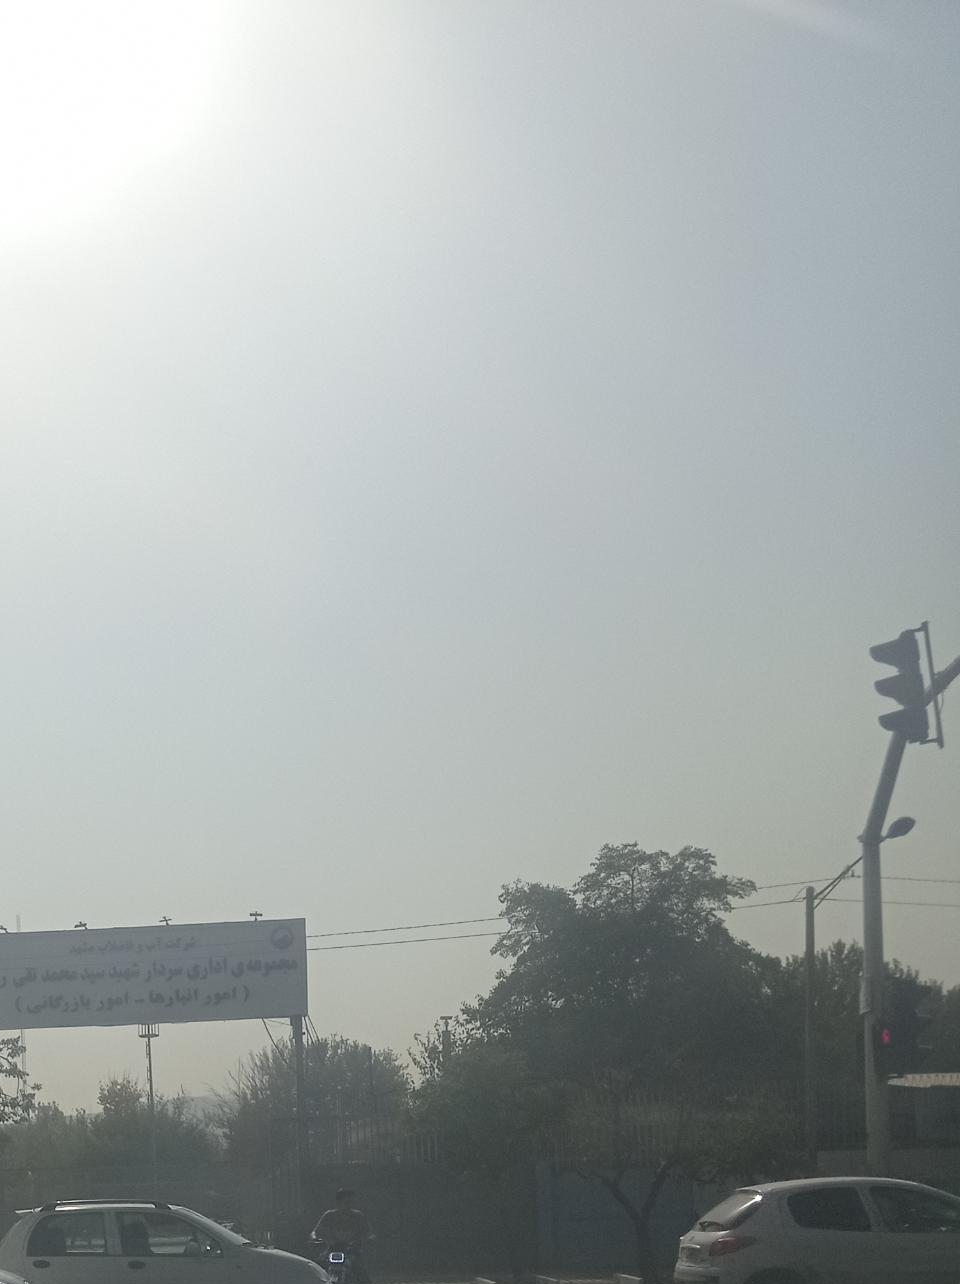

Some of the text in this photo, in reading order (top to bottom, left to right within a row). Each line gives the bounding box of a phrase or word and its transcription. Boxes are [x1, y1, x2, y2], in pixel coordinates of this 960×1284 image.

[40, 968, 78, 983] محمد
[80, 967, 105, 984] سید
[108, 961, 141, 982] شهید
[145, 960, 183, 982] سردار
[187, 957, 228, 980] اداری
[96, 992, 128, 1011] امور
[149, 986, 198, 1007] انبارها
